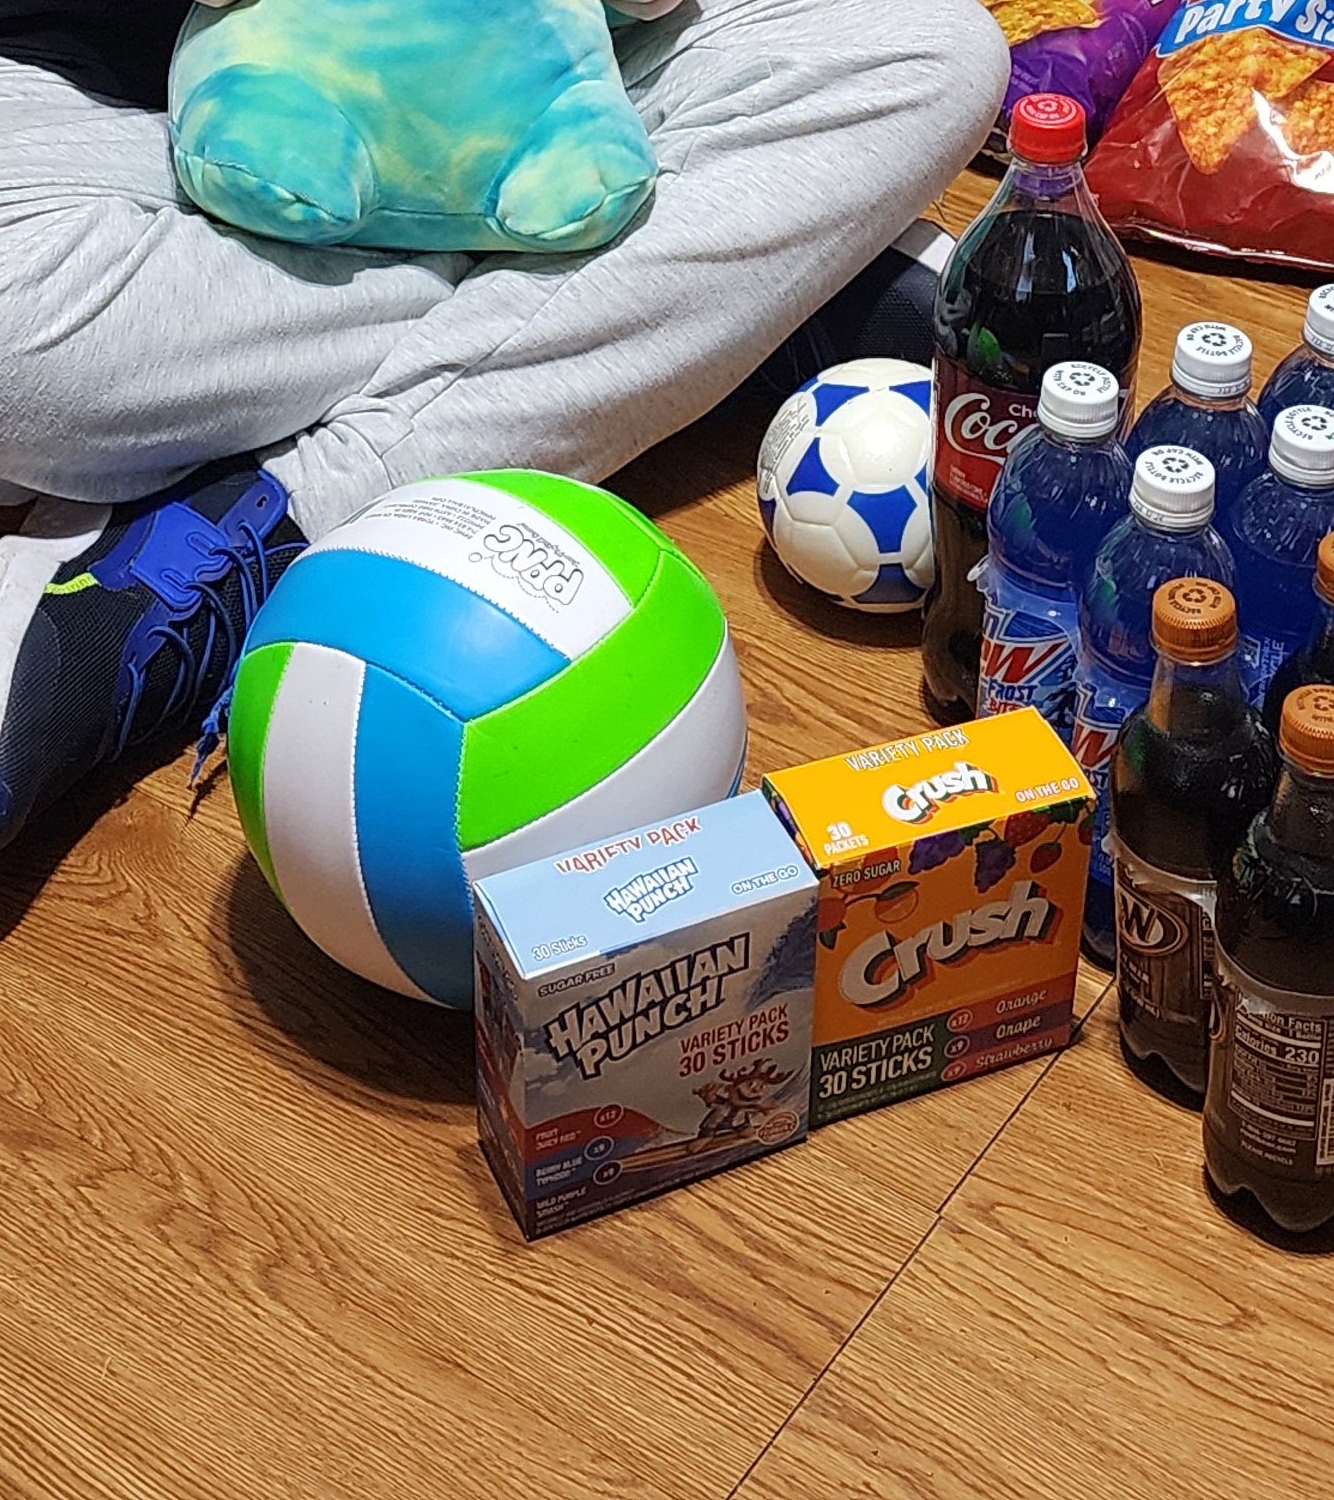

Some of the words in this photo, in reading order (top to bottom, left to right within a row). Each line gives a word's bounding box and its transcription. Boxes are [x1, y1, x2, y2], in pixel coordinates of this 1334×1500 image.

[987, 678, 1039, 699] FROST
[845, 740, 921, 772] VARIETY
[921, 729, 970, 753] PACK
[882, 760, 1000, 825] Crush
[1016, 789, 1037, 803] ON
[1037, 783, 1060, 798] THE
[1060, 777, 1080, 792] GO
[555, 836, 643, 874] VARIETY
[646, 816, 702, 846] PACK
[823, 834, 870, 856] PACKETS
[827, 822, 853, 841] 30
[604, 857, 698, 915] HAWAIIAN
[731, 880, 753, 896] ON
[753, 872, 777, 889] THE
[777, 865, 799, 881] GO
[832, 869, 862, 888] ZERO
[864, 860, 901, 881] SUGAR
[626, 877, 694, 923] PUNCH
[532, 944, 551, 962] 30
[552, 934, 588, 957] Sticks
[839, 880, 1059, 1010] Crush
[538, 972, 584, 997] SUGAR
[584, 963, 615, 984] FREE
[543, 933, 750, 1062] HAWAIIAN
[995, 989, 1047, 1015] Orange
[575, 976, 726, 1080] PUNCH
[679, 1020, 746, 1054] VARIETY
[748, 1003, 788, 1029] PACK
[995, 1016, 1042, 1040] Grape
[1288, 1016, 1323, 1032] Facts
[679, 1051, 707, 1078] 30
[712, 1021, 791, 1067] STICKS
[820, 1038, 895, 1072] VARIETY
[893, 1023, 935, 1053] PACK
[975, 1037, 1054, 1070] Strawberry
[1235, 1025, 1278, 1057] Calories
[1284, 1046, 1320, 1065] 230
[818, 1070, 848, 1098] 30
[851, 1046, 933, 1091] STICKS
[562, 1156, 584, 1170] BLUE
